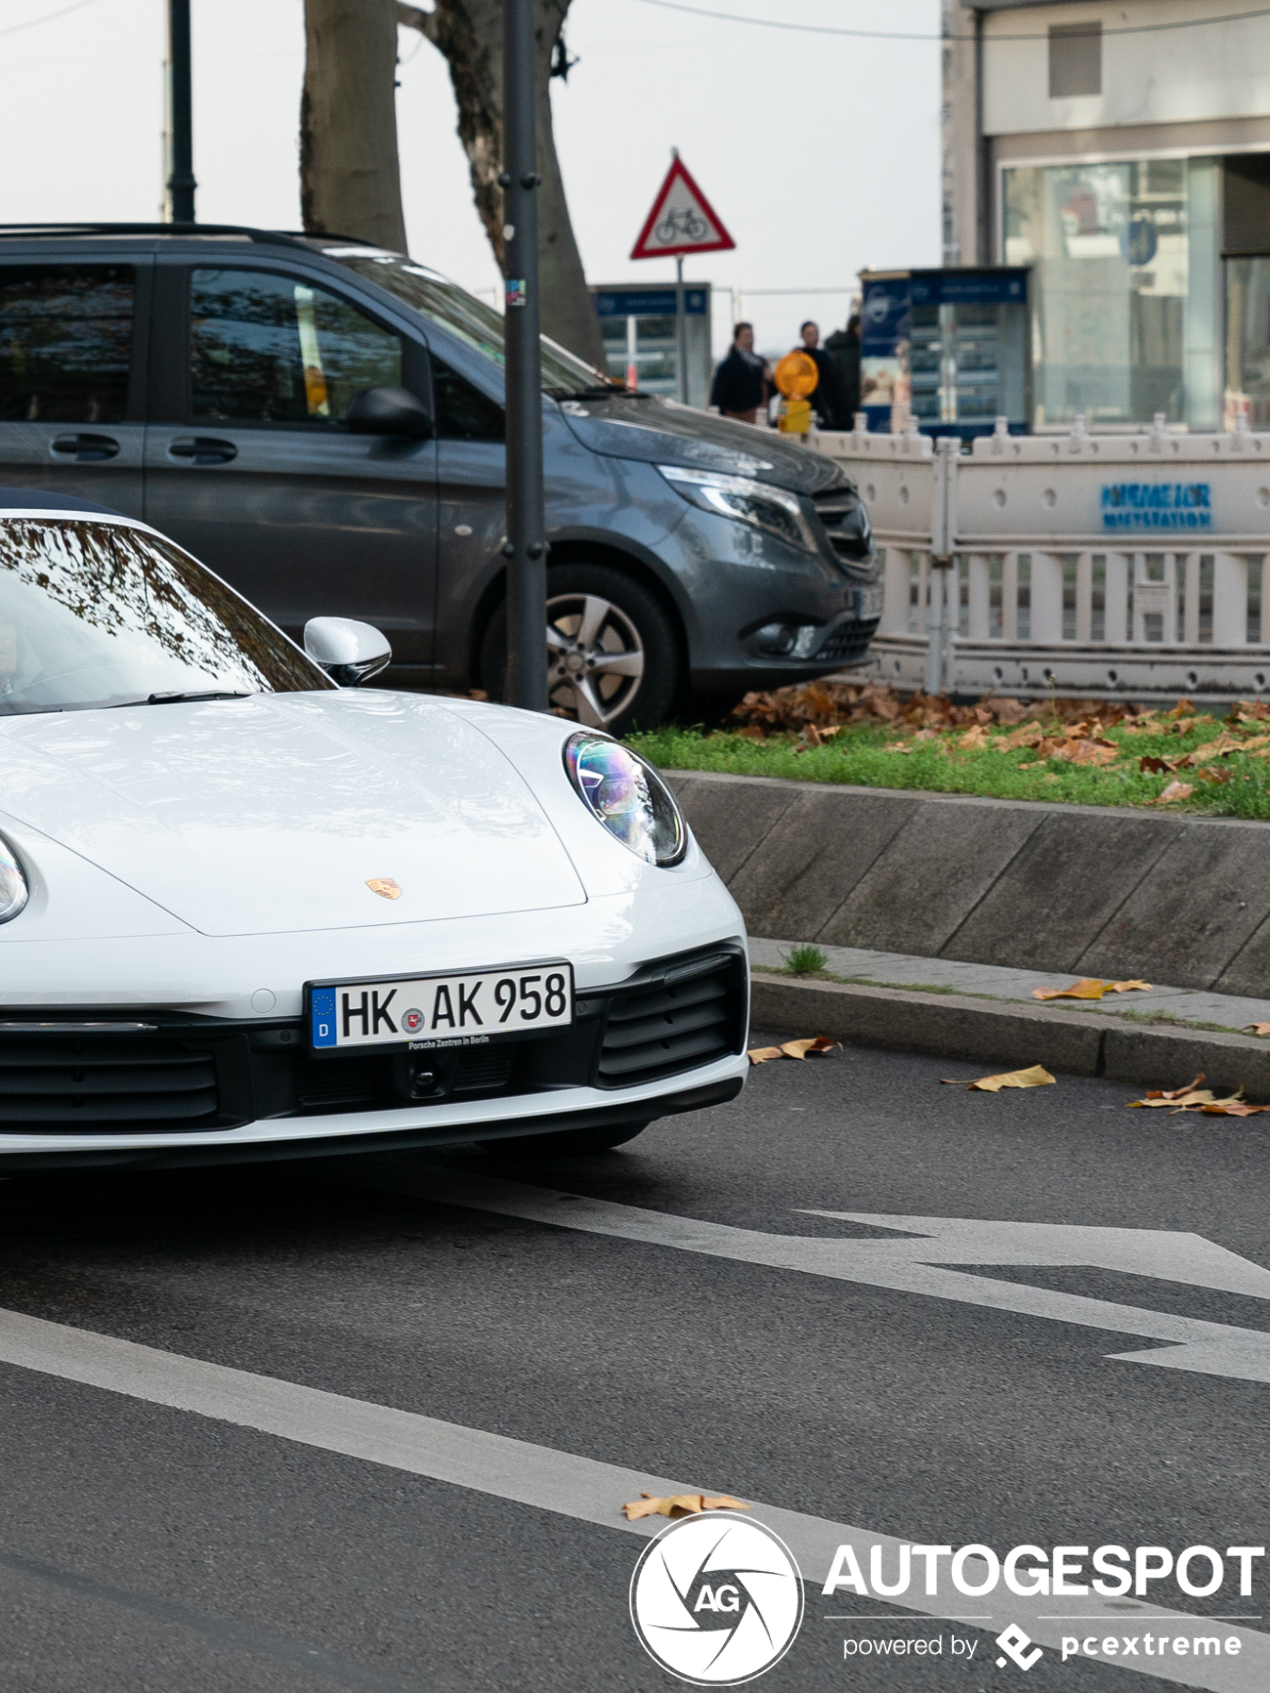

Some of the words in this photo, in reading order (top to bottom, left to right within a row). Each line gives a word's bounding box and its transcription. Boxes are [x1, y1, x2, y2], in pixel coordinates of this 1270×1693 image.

[342, 989, 399, 1037] HK
[431, 981, 484, 1030] AK
[494, 973, 567, 1023] 958
[319, 1024, 329, 1037] D
[408, 1039, 436, 1050] Porsche
[436, 1037, 462, 1049] Zentren
[463, 1037, 470, 1046] in
[470, 1034, 490, 1045] Berlin
